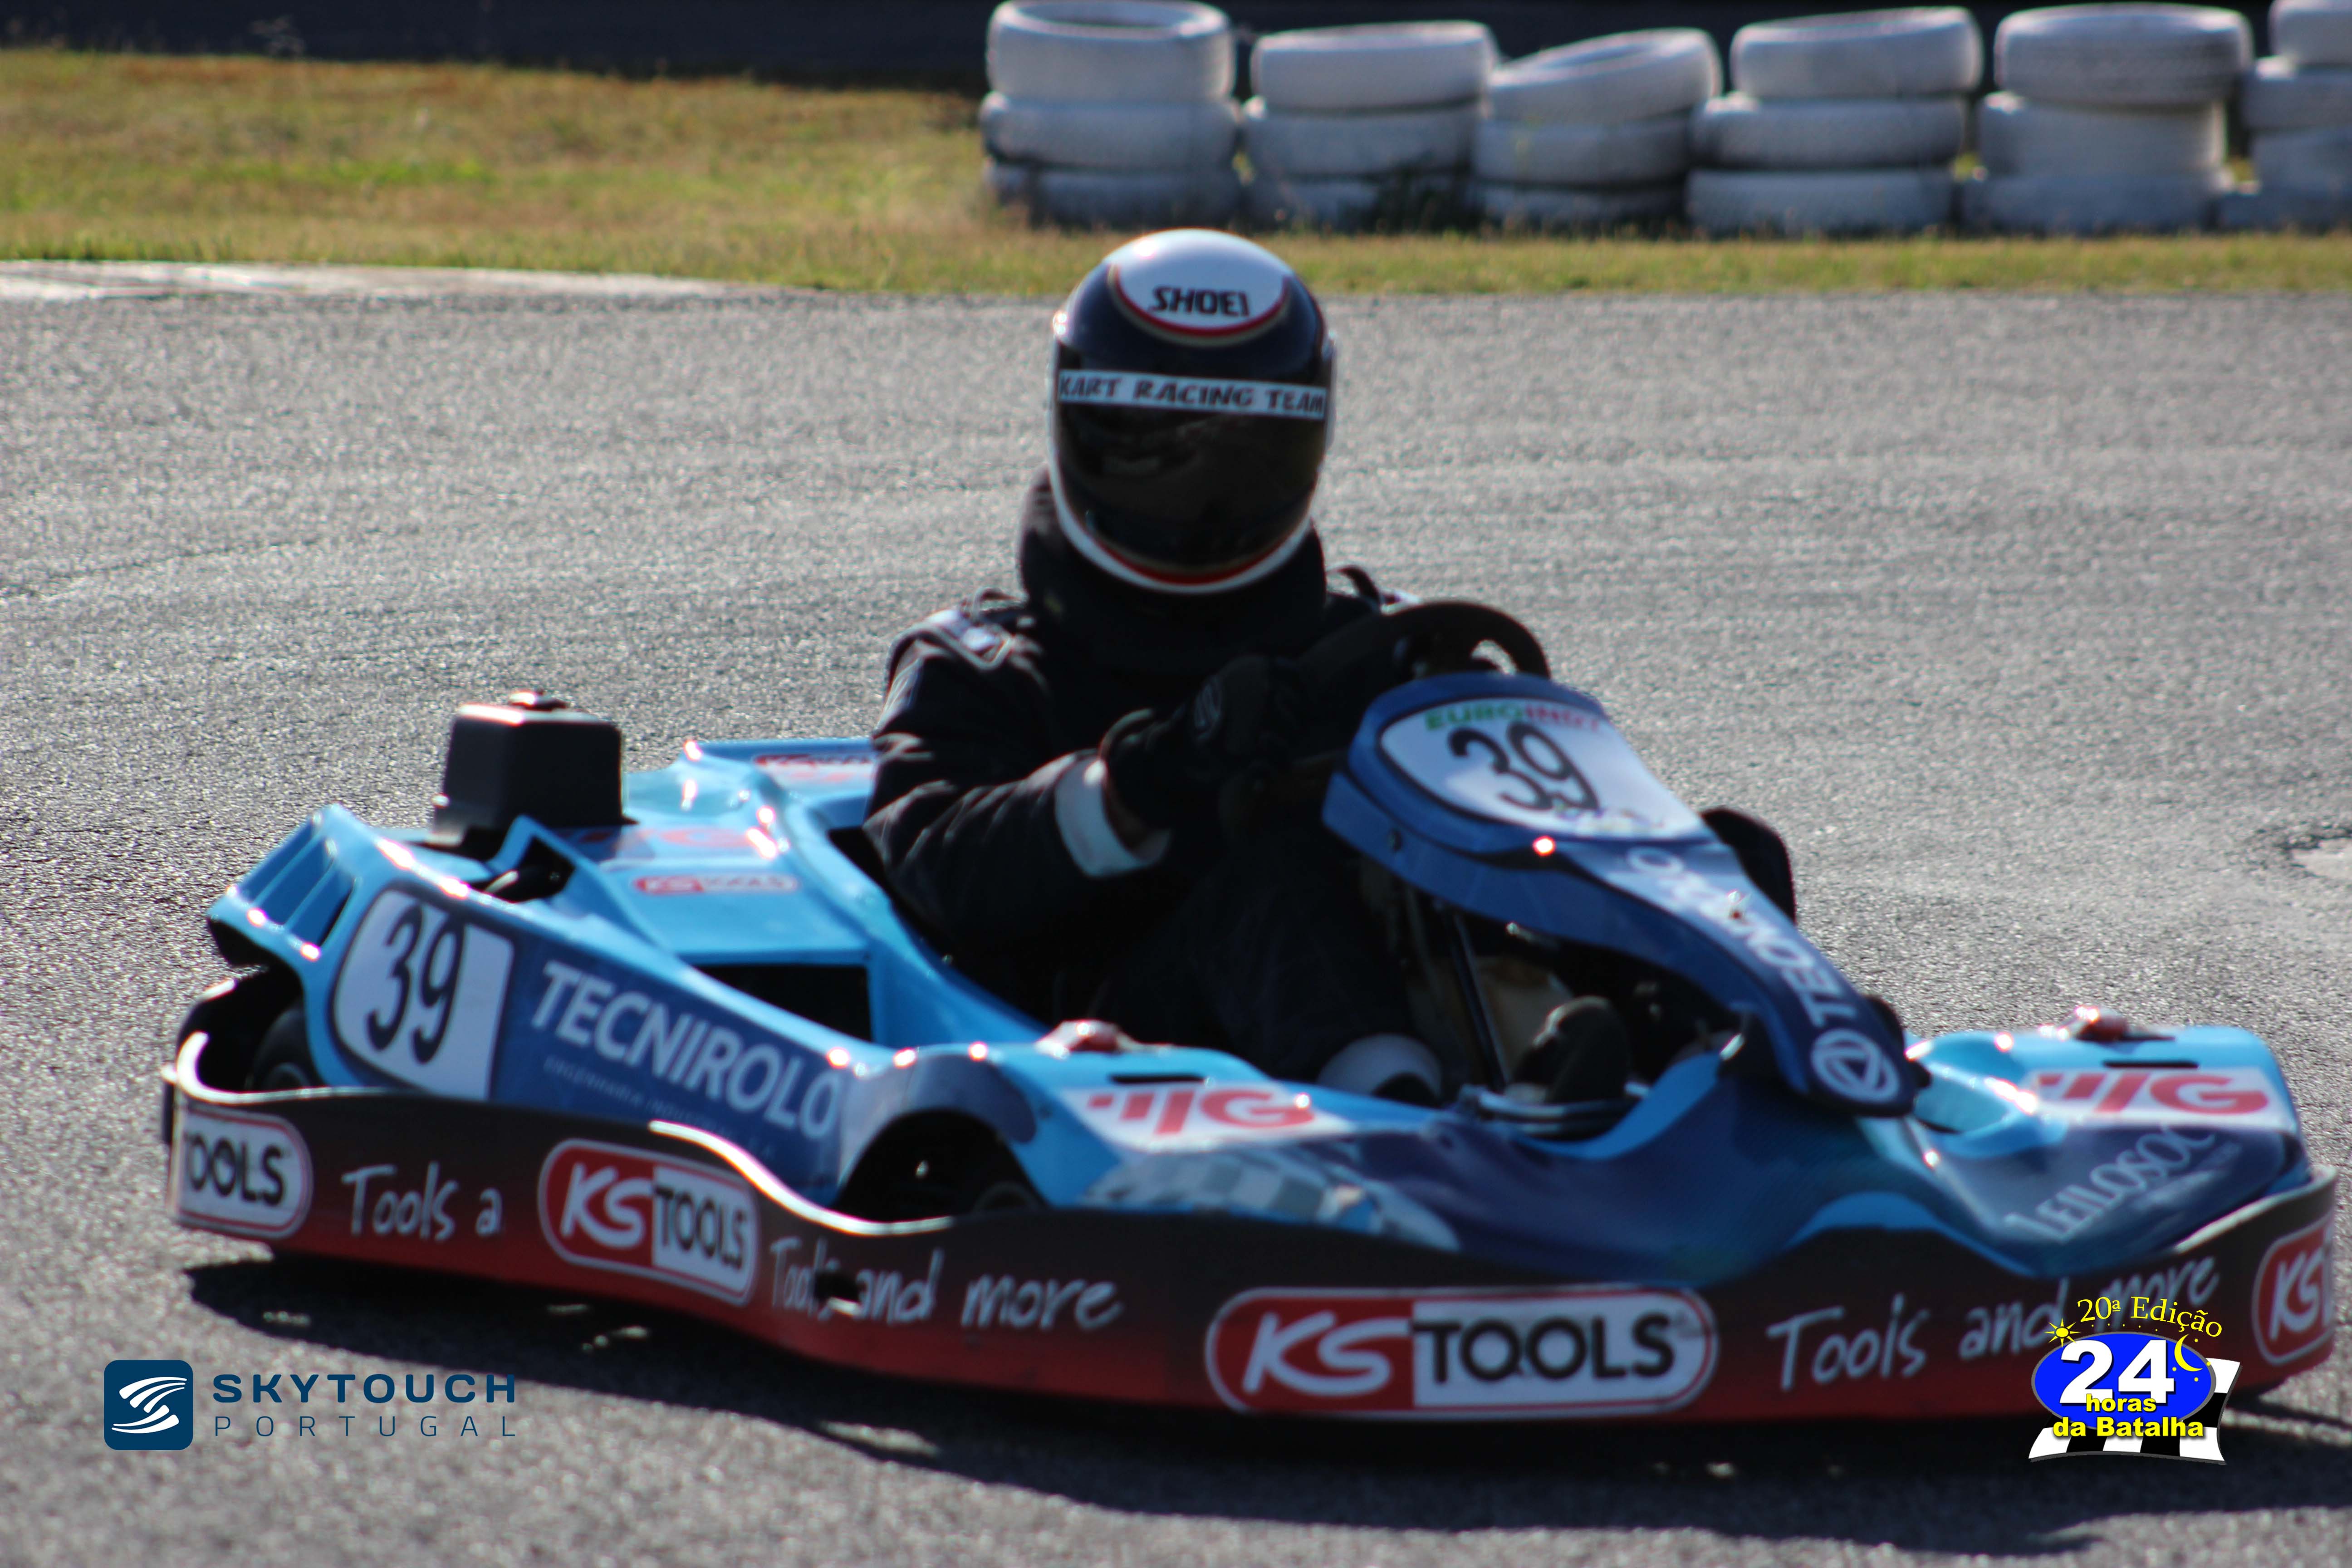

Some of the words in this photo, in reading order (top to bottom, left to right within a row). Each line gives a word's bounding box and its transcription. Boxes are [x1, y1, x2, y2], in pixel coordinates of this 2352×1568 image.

[1148, 285, 1250, 317] SHOEI
[1058, 373, 1122, 398] KART
[1133, 380, 1255, 408] RACING
[1265, 389, 1325, 412] TEAM
[1446, 720, 1600, 811] 39
[366, 903, 467, 1065] 39
[531, 960, 841, 1139] TECNIROLO
[184, 1132, 288, 1207] OOLS
[341, 1161, 458, 1241] Tools
[475, 1187, 504, 1237] a
[560, 1162, 655, 1248] KS
[653, 1184, 748, 1268] TOOLS
[855, 1248, 944, 1324] and
[960, 1274, 1124, 1331] more
[1242, 1311, 1412, 1395] KS
[1408, 1313, 1675, 1384] TOOLS
[1766, 1294, 1929, 1392] Tools
[1959, 1278, 2069, 1360] and
